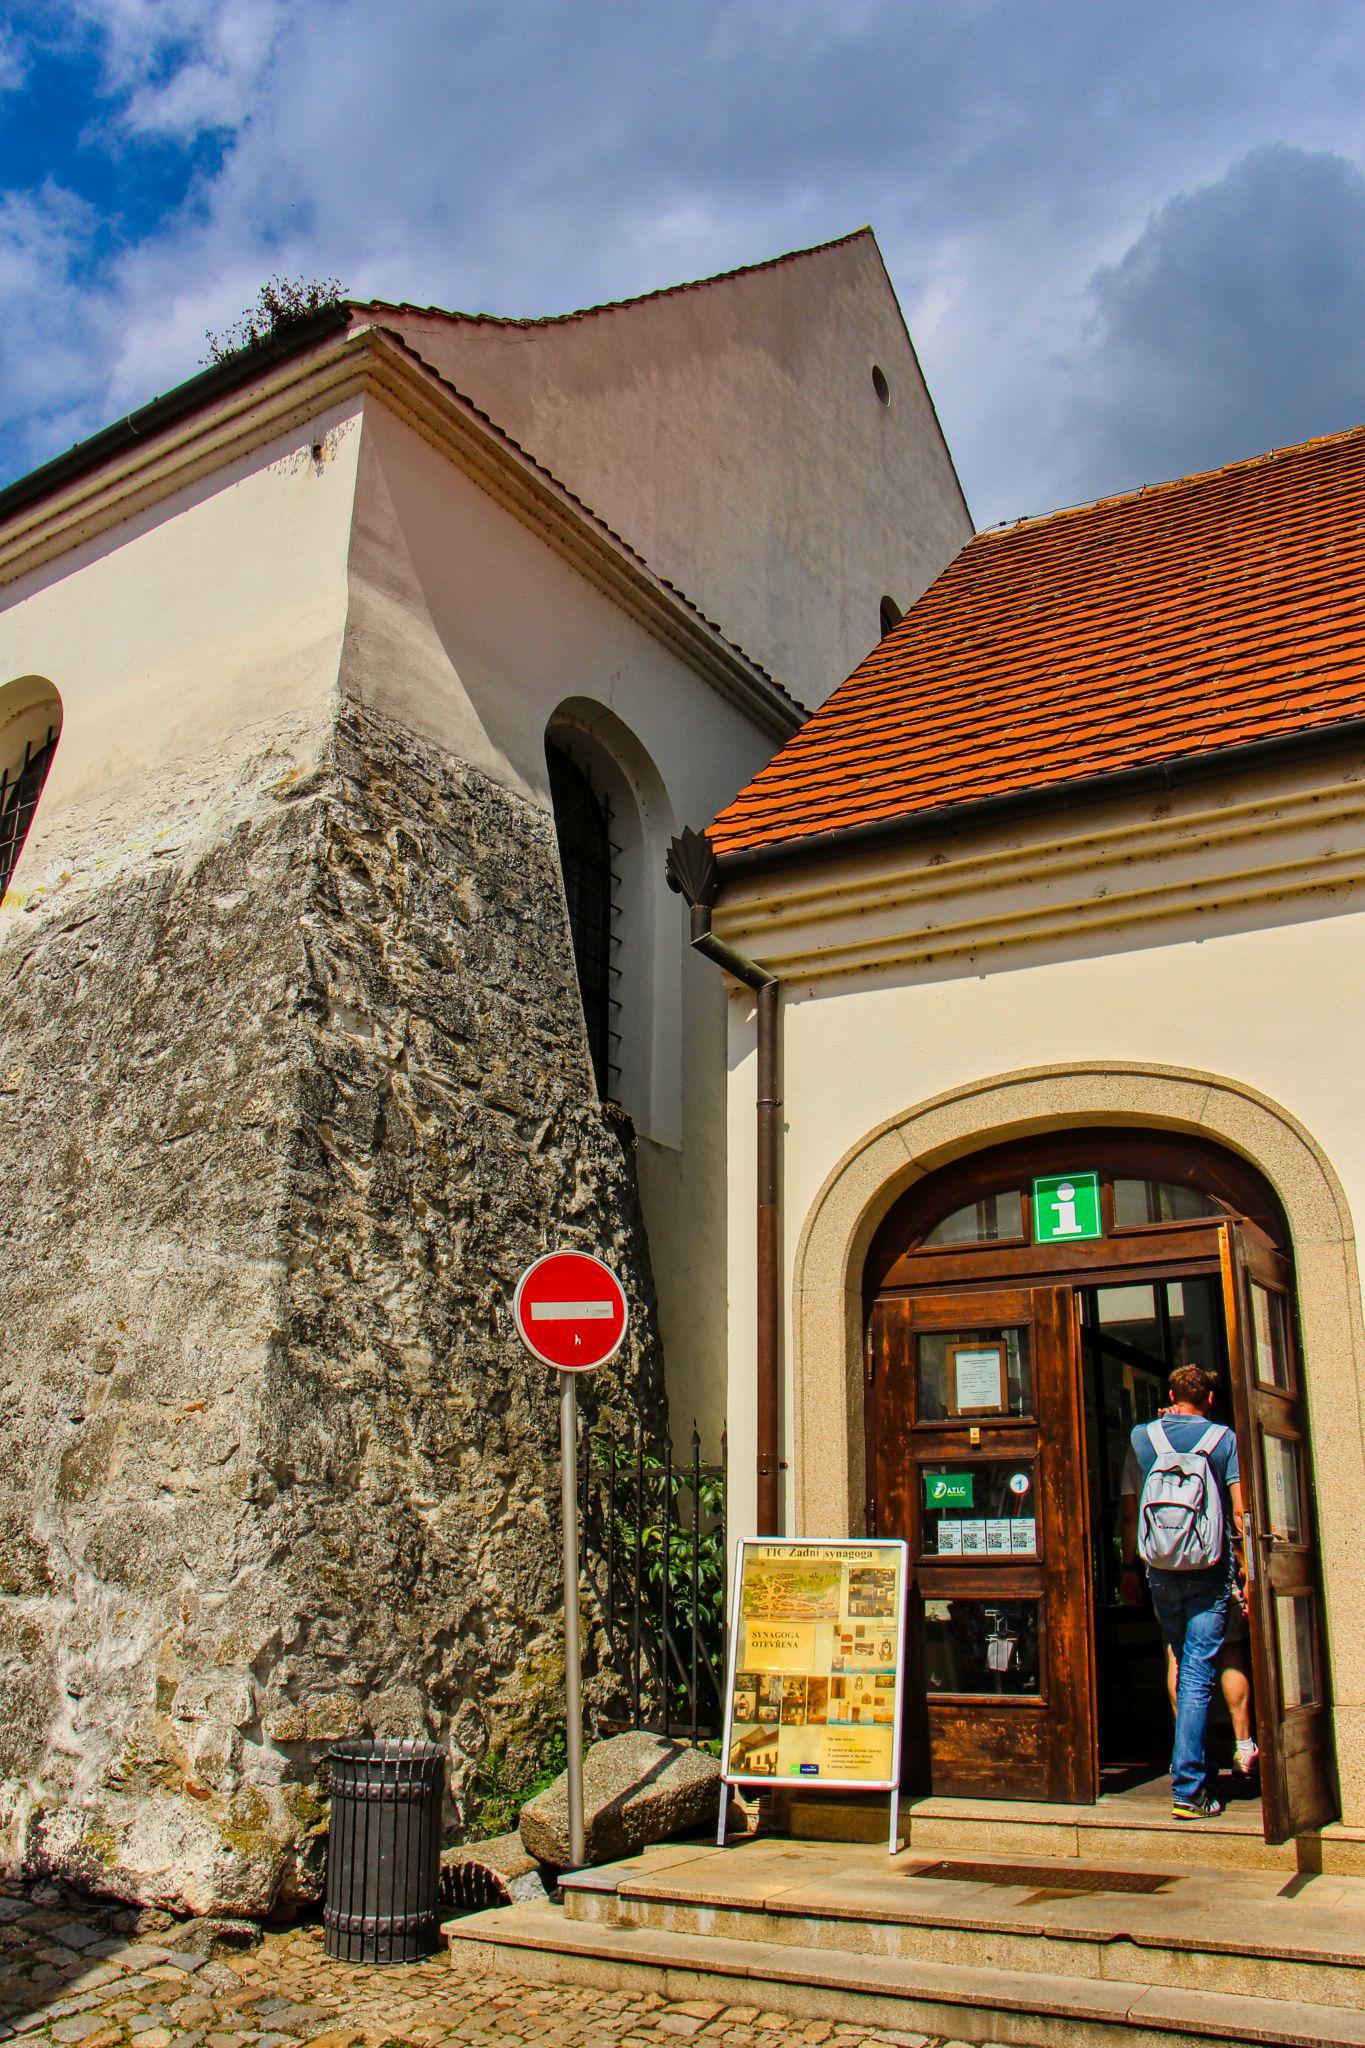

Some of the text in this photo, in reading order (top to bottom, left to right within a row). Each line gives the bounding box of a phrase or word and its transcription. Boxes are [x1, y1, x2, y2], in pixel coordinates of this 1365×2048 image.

[765, 1547, 873, 1560] TIC Zadní synagoga
[752, 1631, 800, 1639] SYNAGOGA
[752, 1639, 798, 1648] OTEVŘENA
